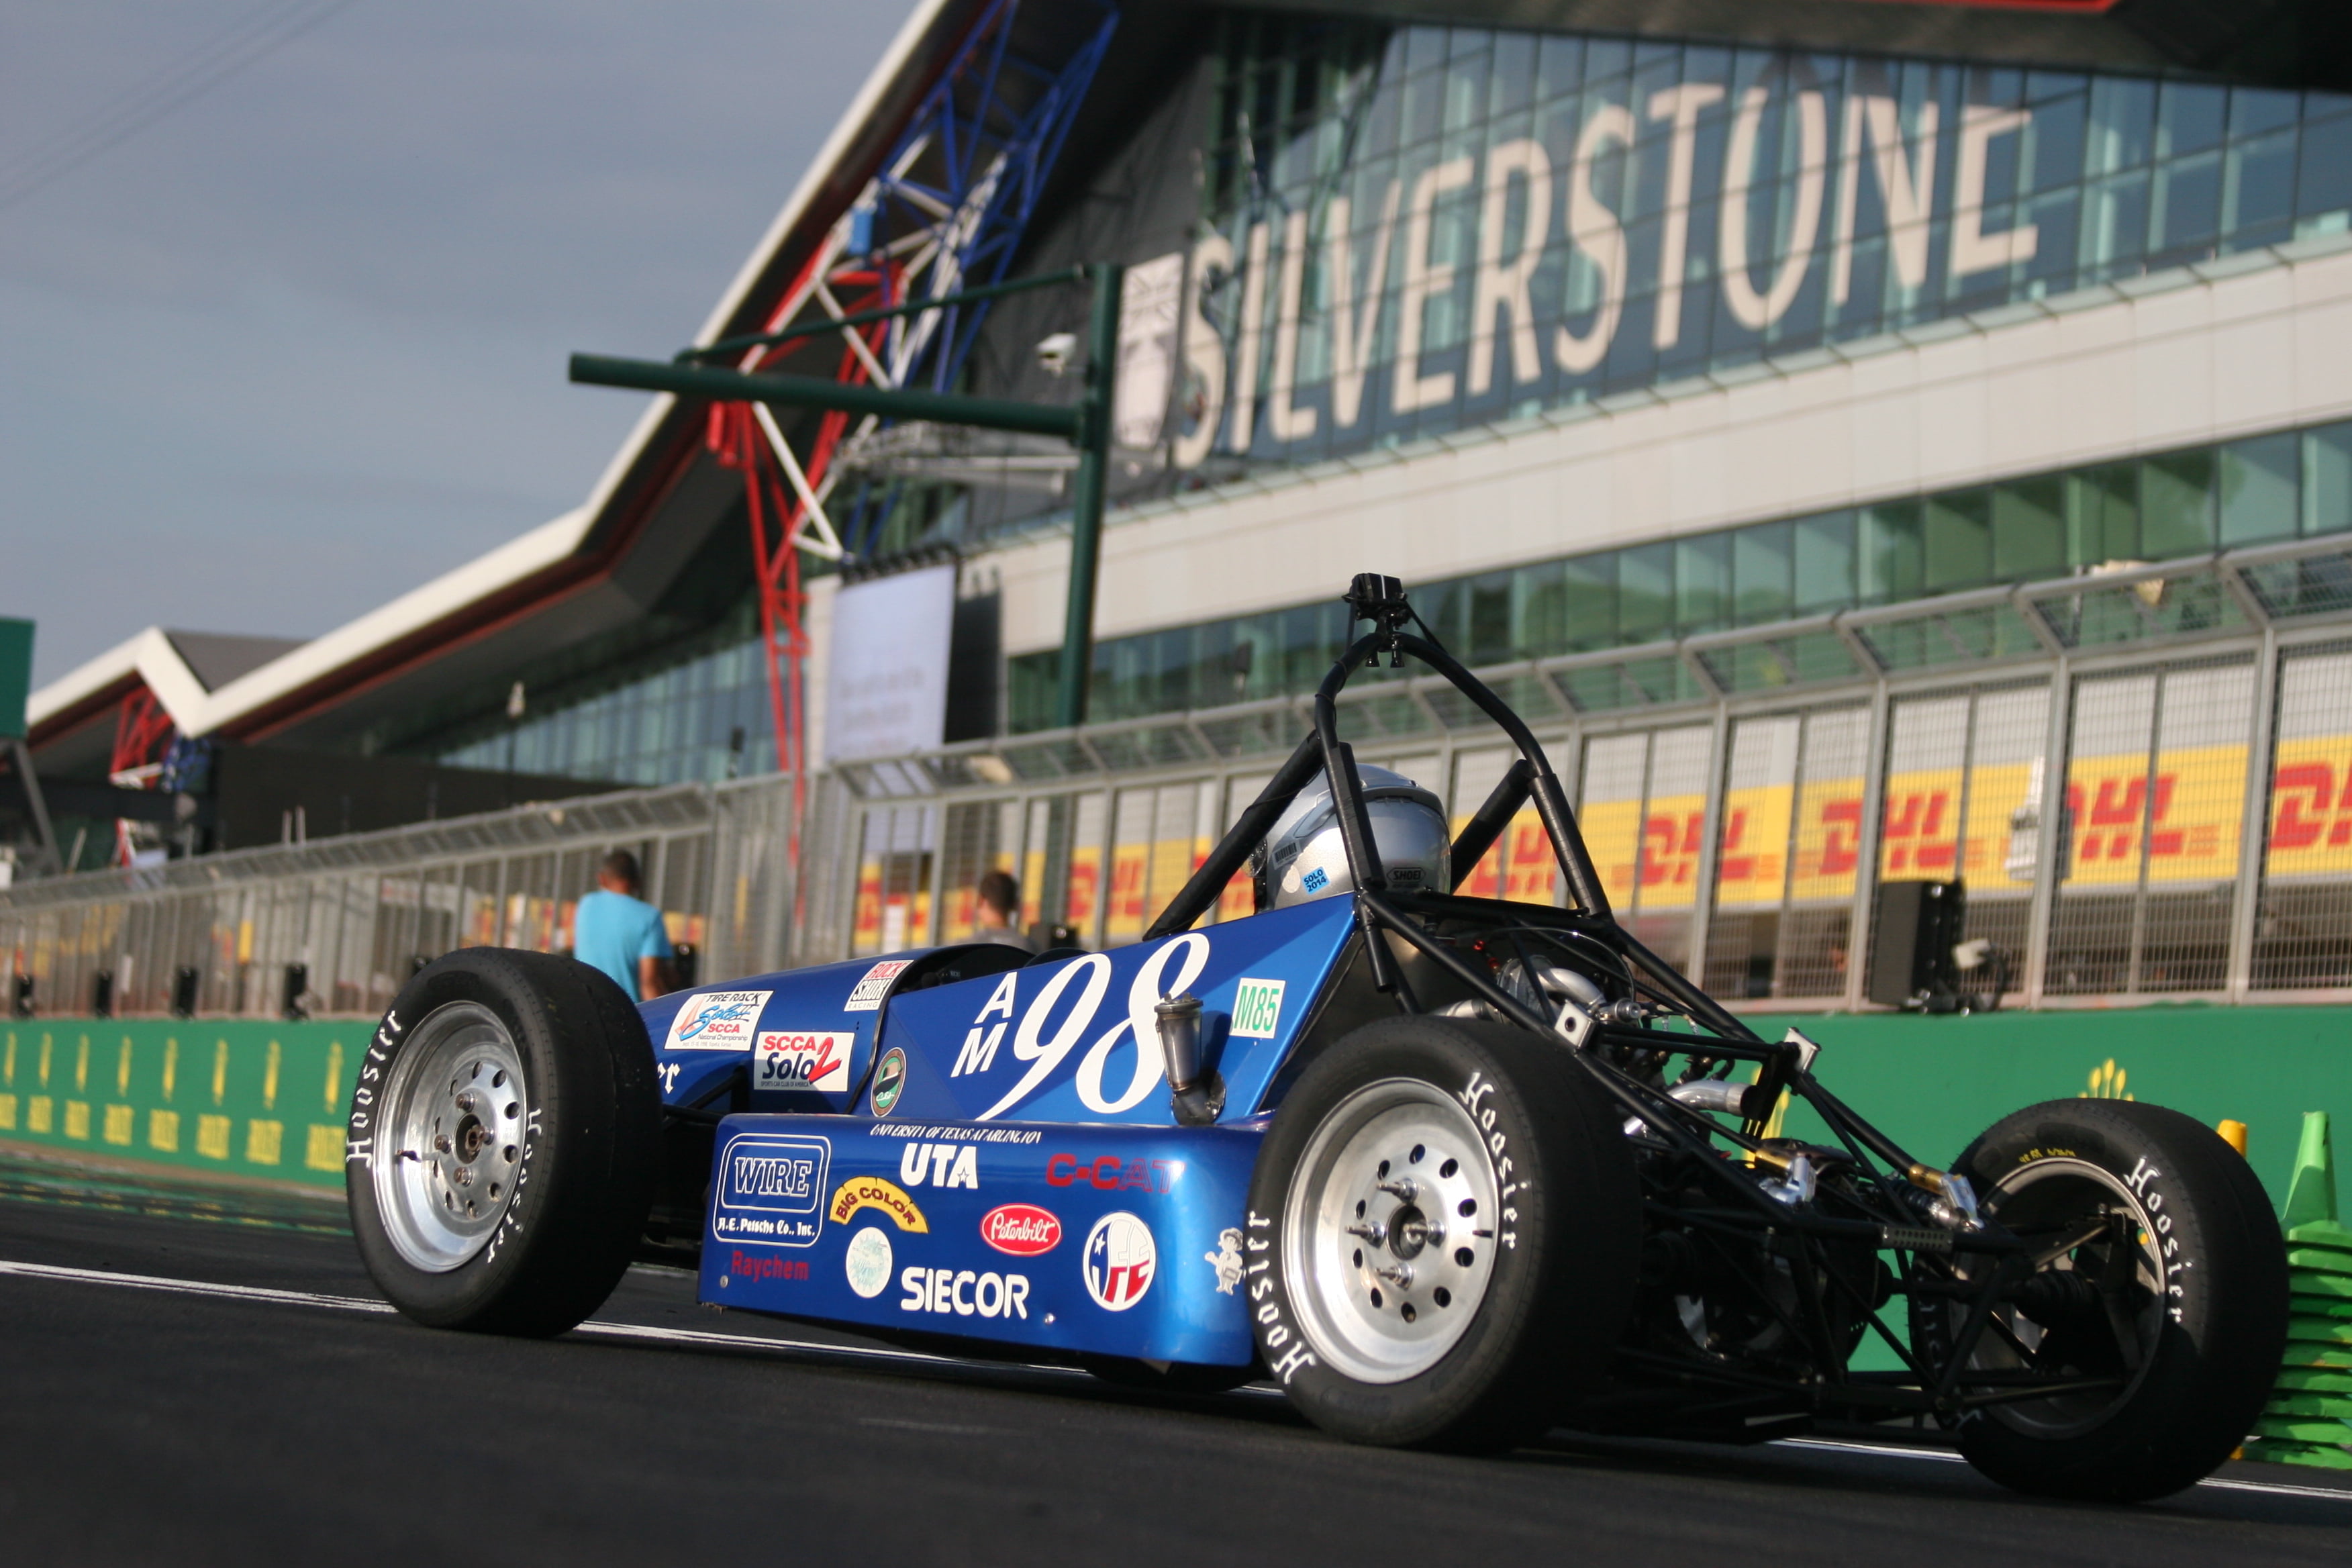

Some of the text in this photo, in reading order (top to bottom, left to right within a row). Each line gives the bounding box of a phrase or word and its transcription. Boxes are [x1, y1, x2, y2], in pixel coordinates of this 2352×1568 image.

[1173, 82, 2039, 468] SILVERSTONE
[1303, 868, 1324, 885] SOLO
[1308, 875, 1328, 892] 2014
[1393, 870, 1422, 881] SHOEI
[866, 961, 908, 979] ROCK
[852, 979, 891, 1001] SHOX
[1234, 985, 1280, 1032] M85
[707, 1023, 740, 1033] SCCA
[763, 1036, 816, 1051] SCCA
[976, 932, 1210, 1122] 98
[762, 1036, 842, 1085] Solo 2
[346, 1010, 402, 1169] Hoosier
[926, 1126, 944, 1139] OF
[940, 1127, 971, 1140] TEXAS
[969, 1128, 989, 1141] AT
[735, 1157, 813, 1197] WIRE
[900, 1142, 978, 1189] UTA
[1458, 1072, 1532, 1250] Hoosier
[836, 1187, 916, 1226] BIG COLOR
[797, 1222, 816, 1236] Inc.
[990, 1212, 1056, 1242] Peterbilt
[2123, 1156, 2195, 1324] Hoosier
[732, 1250, 810, 1283] Raychem
[900, 1266, 1030, 1320] SIECOR
[1246, 1210, 1316, 1385] Hoosier
